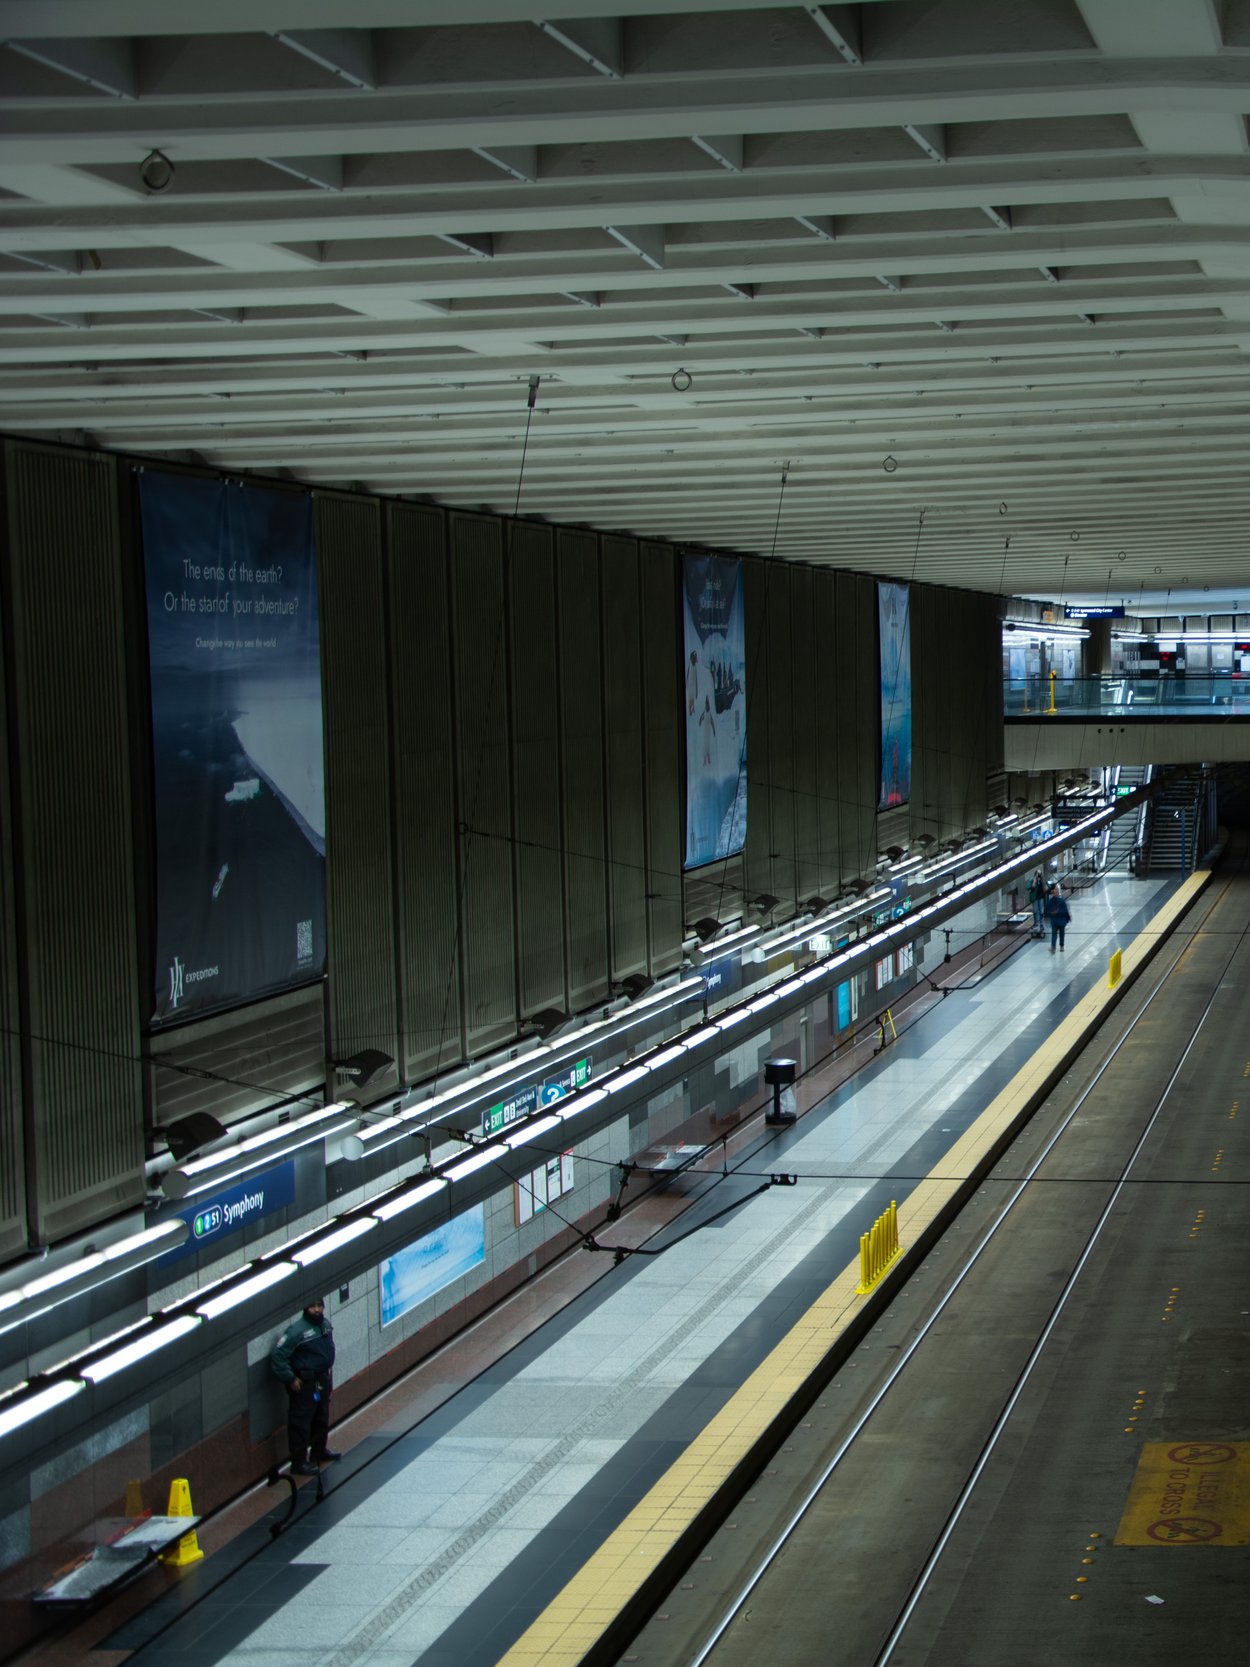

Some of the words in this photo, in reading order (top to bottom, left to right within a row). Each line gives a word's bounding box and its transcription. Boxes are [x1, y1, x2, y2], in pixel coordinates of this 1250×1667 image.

[182, 558, 200, 580] The
[228, 560, 237, 580] of
[240, 562, 253, 582] the
[256, 564, 283, 584] earth?
[164, 591, 178, 612] Or
[181, 590, 196, 612] the
[199, 594, 219, 612] start
[219, 592, 230, 613] of
[233, 600, 252, 616] your
[254, 594, 299, 616] adventure?
[186, 965, 219, 983] EXPEDITIONS
[577, 1067, 586, 1082] EXIT
[491, 1110, 502, 1129] EXIT
[212, 1210, 219, 1226] 51
[224, 1190, 264, 1224] Symphony
[1170, 1468, 1190, 1480] TO
[1160, 1482, 1186, 1515] CROSS
